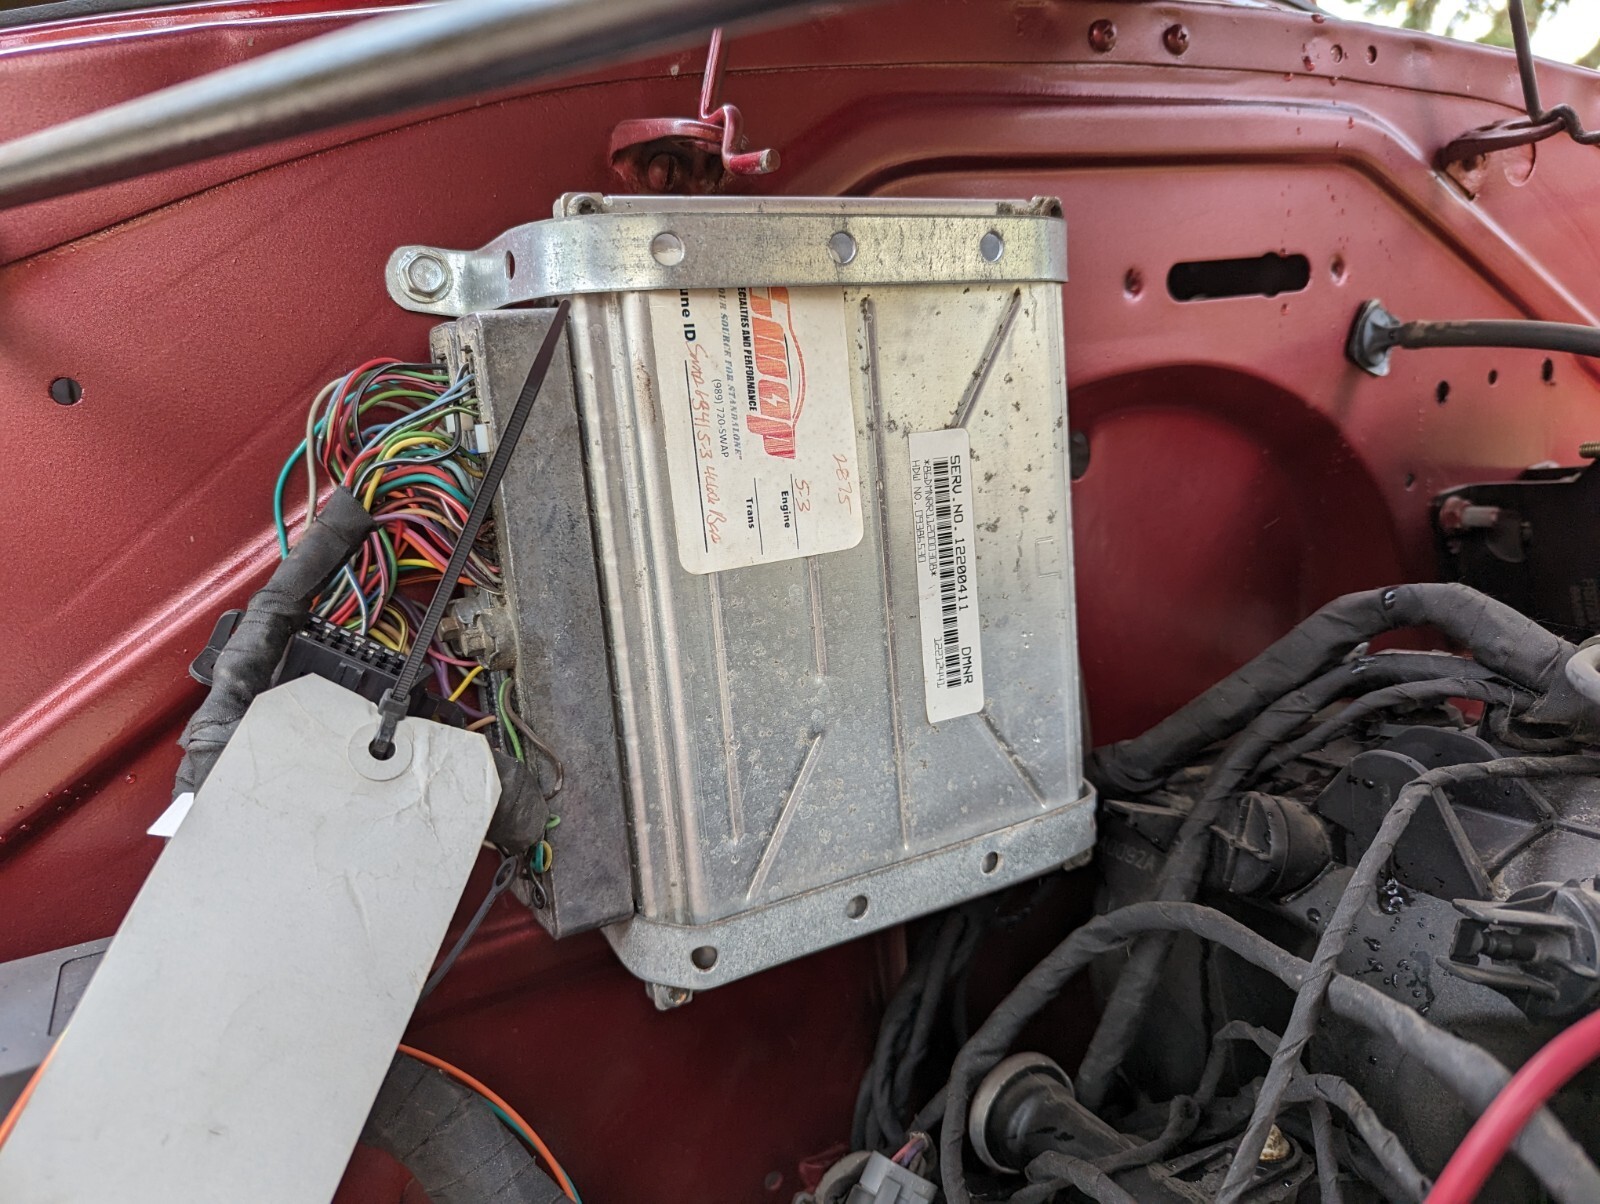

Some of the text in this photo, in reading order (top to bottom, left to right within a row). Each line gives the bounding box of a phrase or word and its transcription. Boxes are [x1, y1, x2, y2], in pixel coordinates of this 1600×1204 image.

[680, 288, 697, 342] une ID
[717, 288, 727, 309] OUR
[720, 313, 732, 358] SOURCE
[738, 287, 758, 412] ECIALTIES AND PERFORMANCE
[725, 361, 734, 381] FOR
[712, 379, 729, 458] (989) 720-SWAP
[912, 460, 921, 481] HDW
[746, 497, 755, 529] Trans
[780, 490, 791, 529] Engine
[934, 637, 946, 688] 12212441
[961, 646, 974, 684] DMNR
